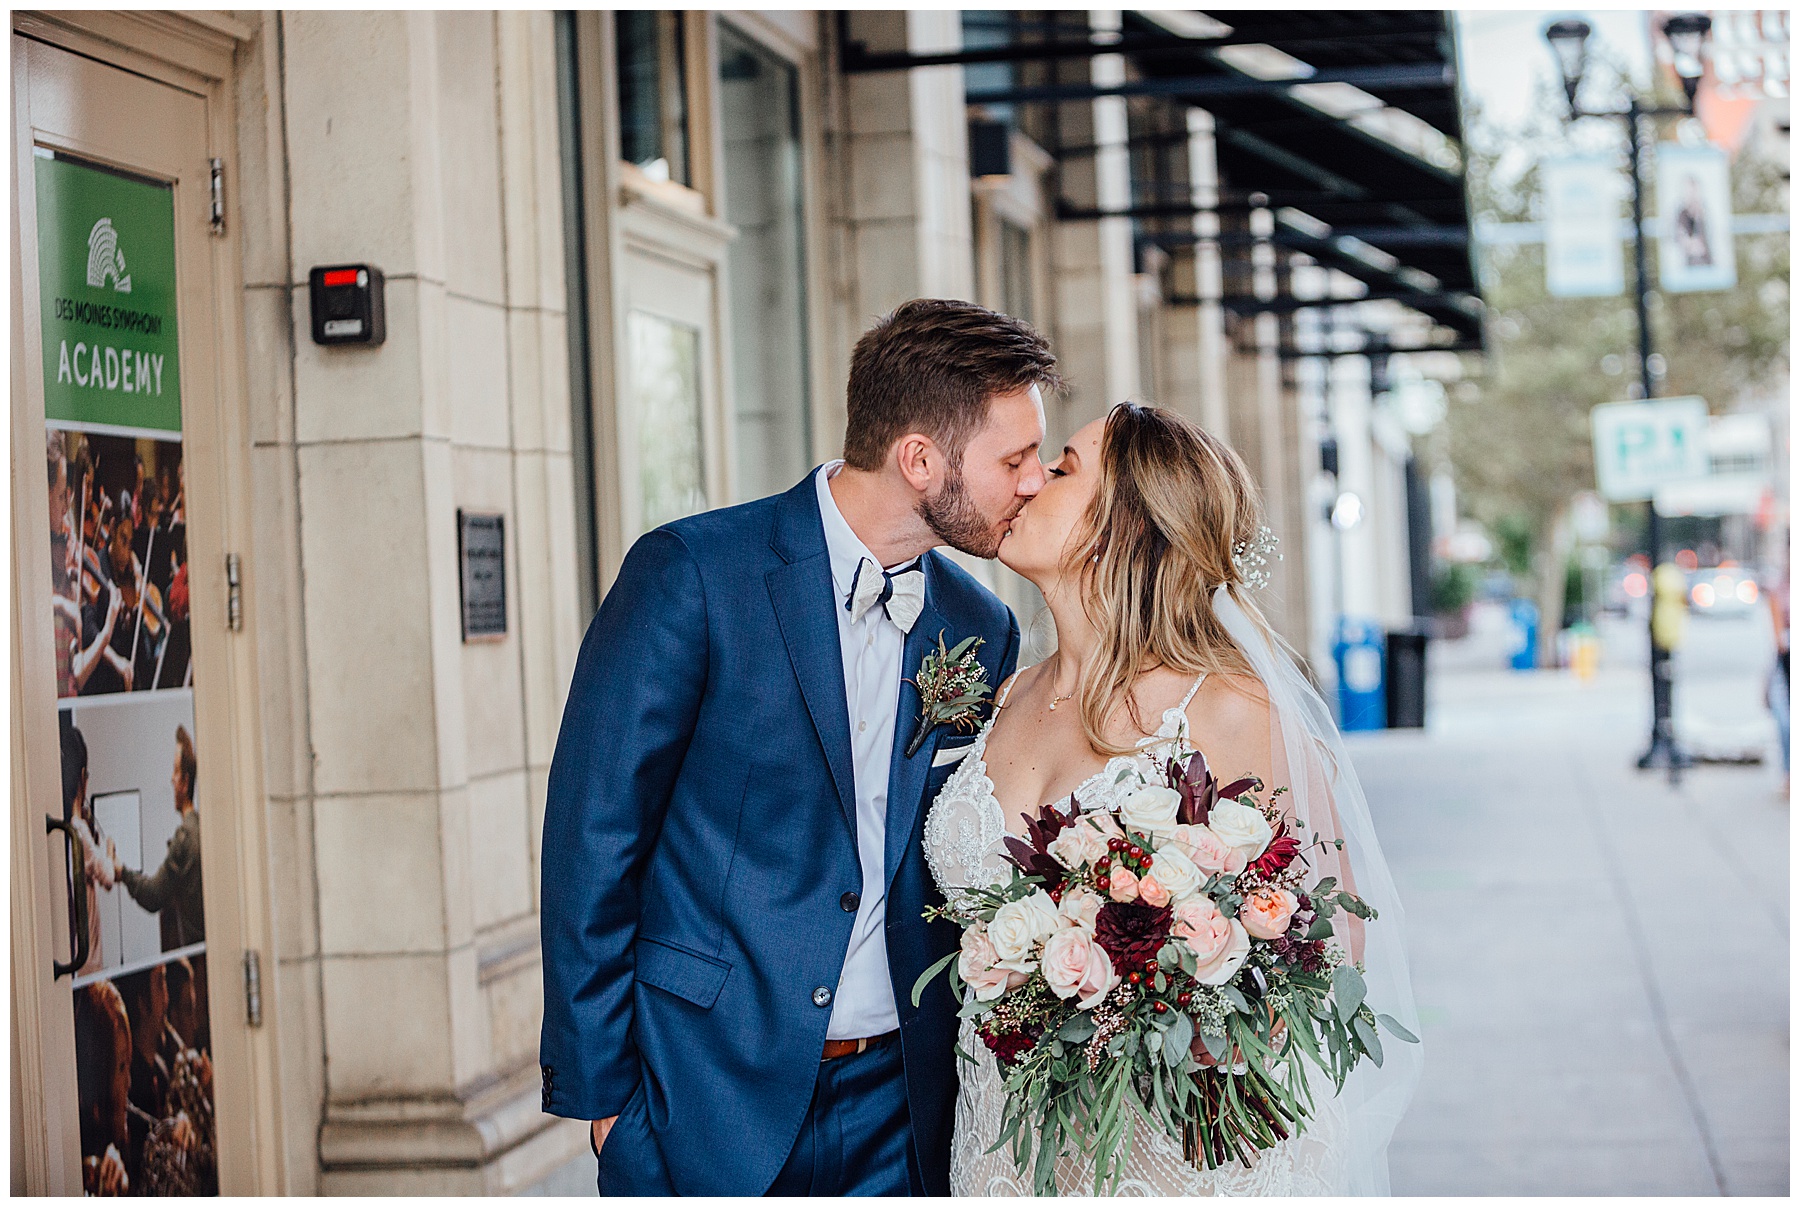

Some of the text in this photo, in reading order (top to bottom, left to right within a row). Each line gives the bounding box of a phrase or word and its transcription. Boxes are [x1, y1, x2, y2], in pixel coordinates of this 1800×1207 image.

[55, 298, 162, 335] DES MOINES SYMPHONY
[57, 339, 164, 397] ACADEMY
